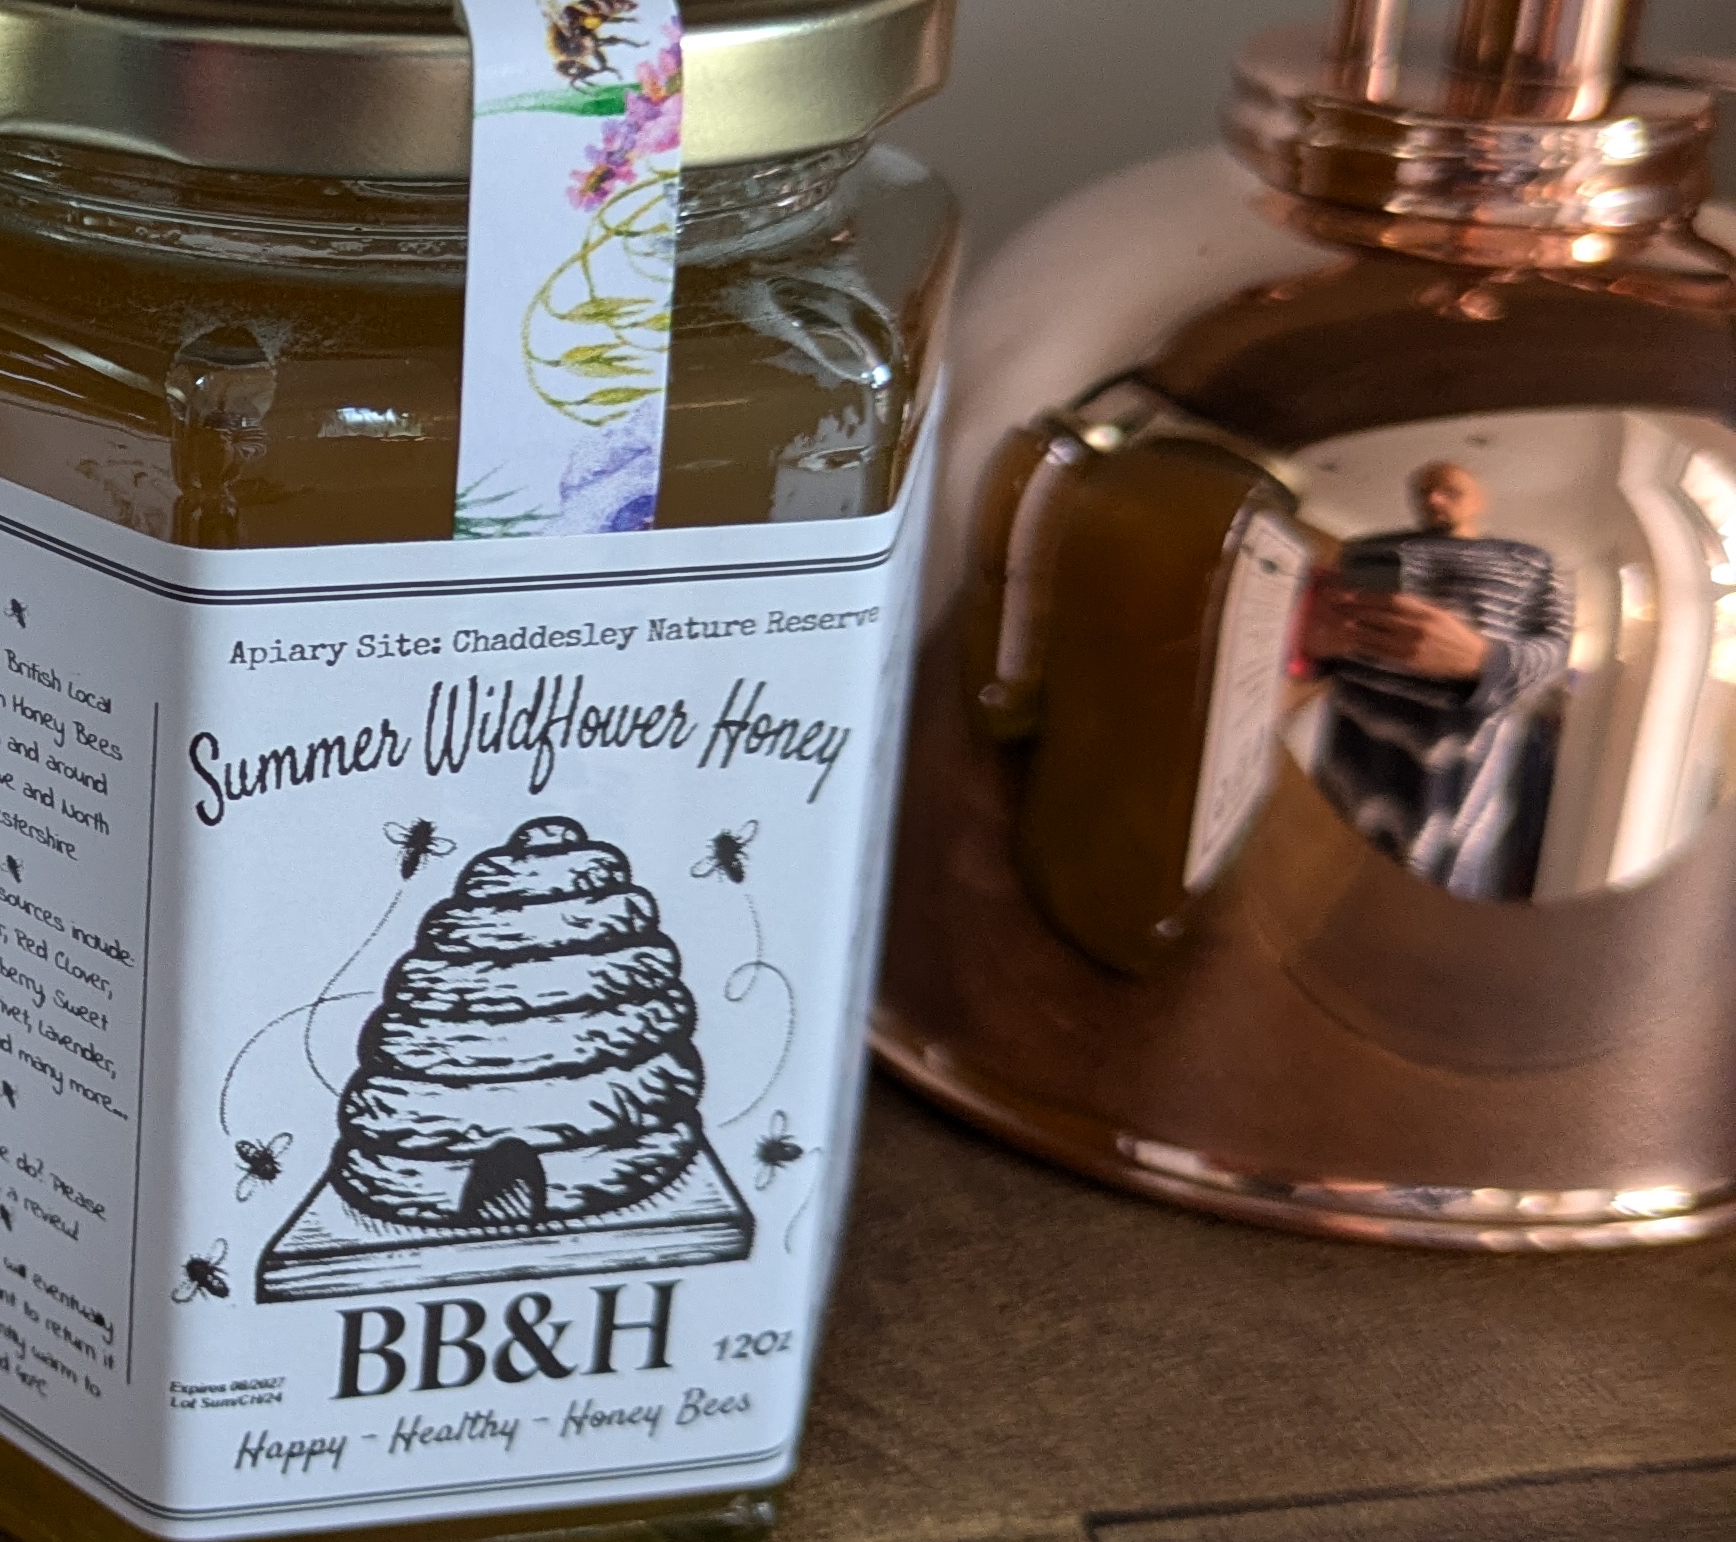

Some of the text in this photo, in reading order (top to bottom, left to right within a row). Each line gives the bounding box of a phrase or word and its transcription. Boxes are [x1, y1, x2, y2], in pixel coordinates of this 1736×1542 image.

[229, 606, 880, 670] Apiary Site: Chaddesley Nature Reserve
[5, 649, 61, 692] British
[68, 681, 111, 714] Local
[13, 695, 64, 747] Honey
[73, 721, 123, 761] Bees
[189, 674, 852, 827] Summer Wildflower Honey
[8, 736, 39, 763] and
[46, 754, 108, 795] around
[23, 782, 53, 808] and
[62, 799, 110, 835] North
[15, 928, 47, 961] Red
[55, 951, 112, 1000] Clover,
[53, 989, 108, 1031] Sweet
[19, 1049, 64, 1095] many
[38, 1020, 116, 1079] Lavender,
[329, 1279, 683, 1400] BB&H
[234, 1429, 347, 1475] Happy
[387, 1409, 519, 1452] Healthy
[559, 1398, 664, 1438] Honey
[675, 1386, 751, 1427] Bees
